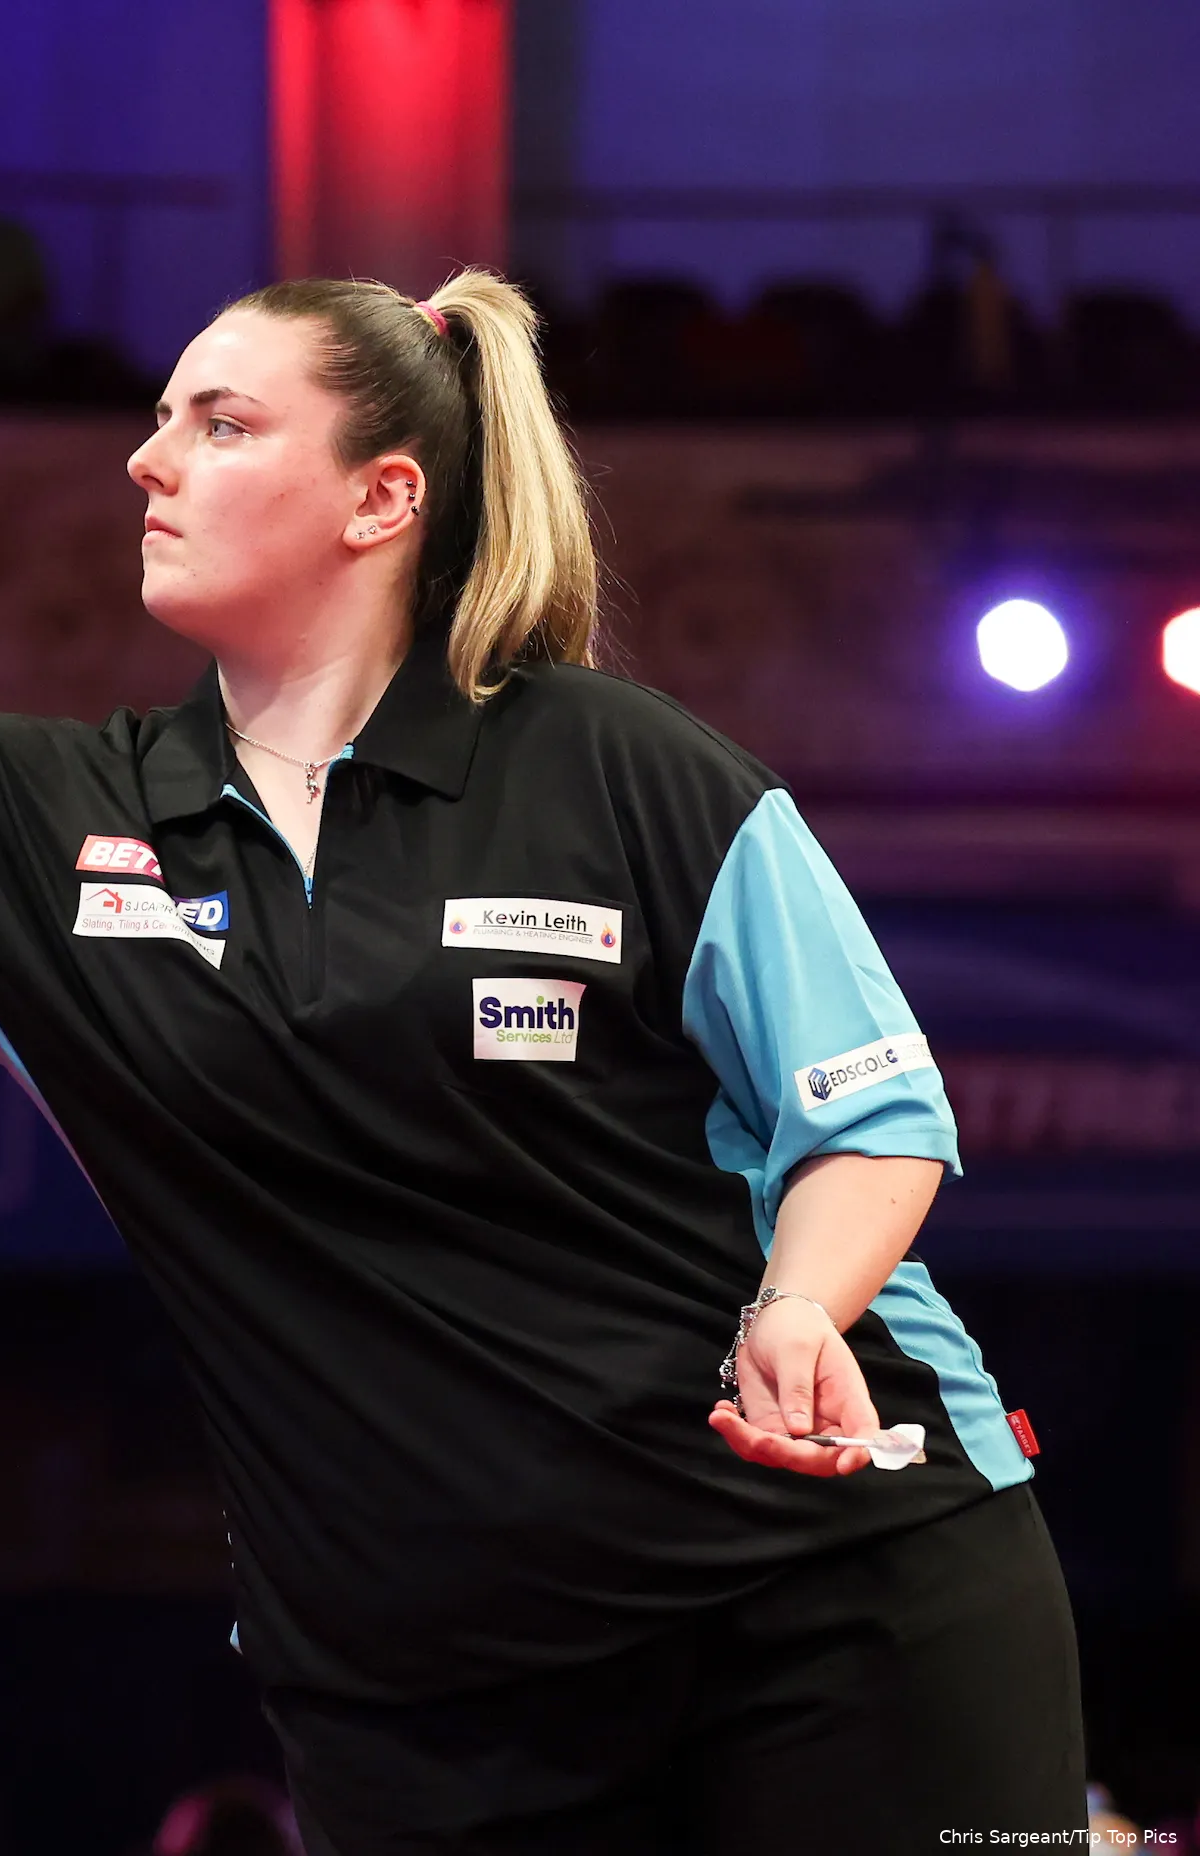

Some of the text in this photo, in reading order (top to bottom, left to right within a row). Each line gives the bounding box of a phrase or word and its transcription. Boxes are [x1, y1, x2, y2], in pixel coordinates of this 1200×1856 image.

[119, 919, 141, 931] Tiling
[143, 919, 149, 930] &
[483, 910, 587, 932] Kevin Leith
[473, 928, 513, 937] PLUMBING
[523, 930, 557, 940] HEATING
[558, 934, 594, 945] ENGINEER
[479, 995, 575, 1030] Smith
[496, 1029, 575, 1044] Services Ltd
